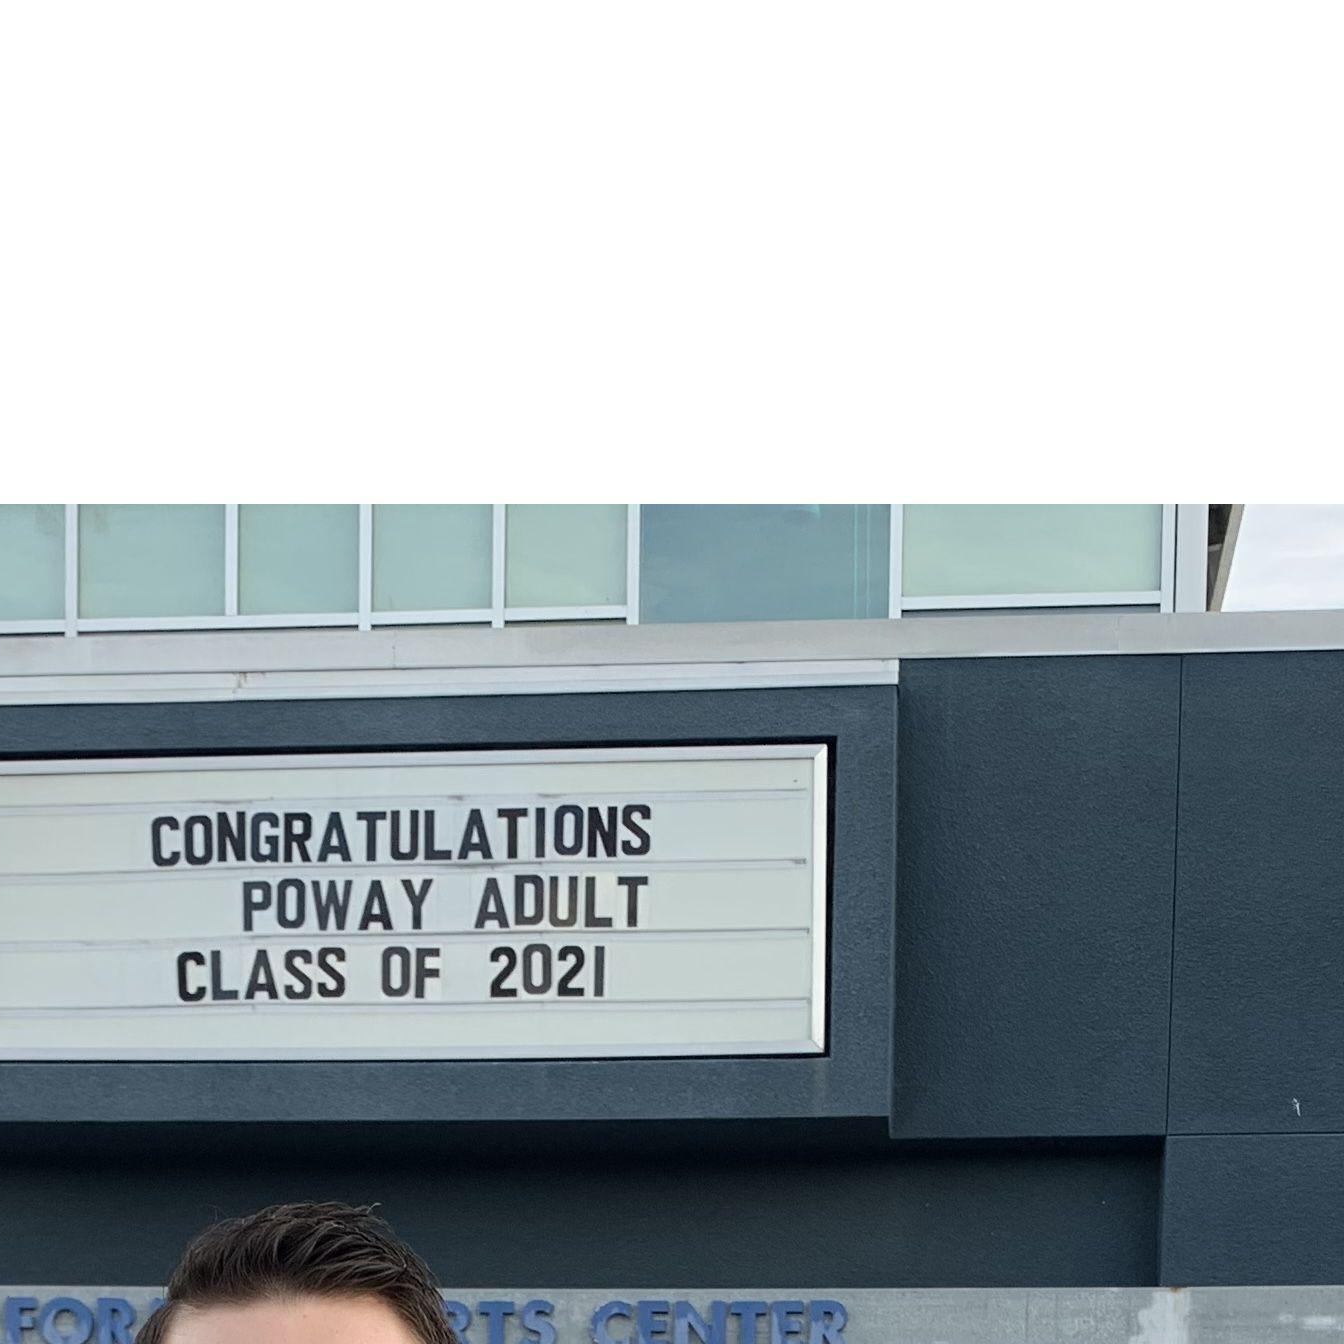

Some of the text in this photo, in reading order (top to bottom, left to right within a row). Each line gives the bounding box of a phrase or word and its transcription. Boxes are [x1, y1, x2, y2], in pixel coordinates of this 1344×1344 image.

[151, 804, 652, 867] CONGRATULATIONS
[242, 874, 649, 932] POWAY ADULT
[176, 943, 606, 1002] CLASS OF 2021
